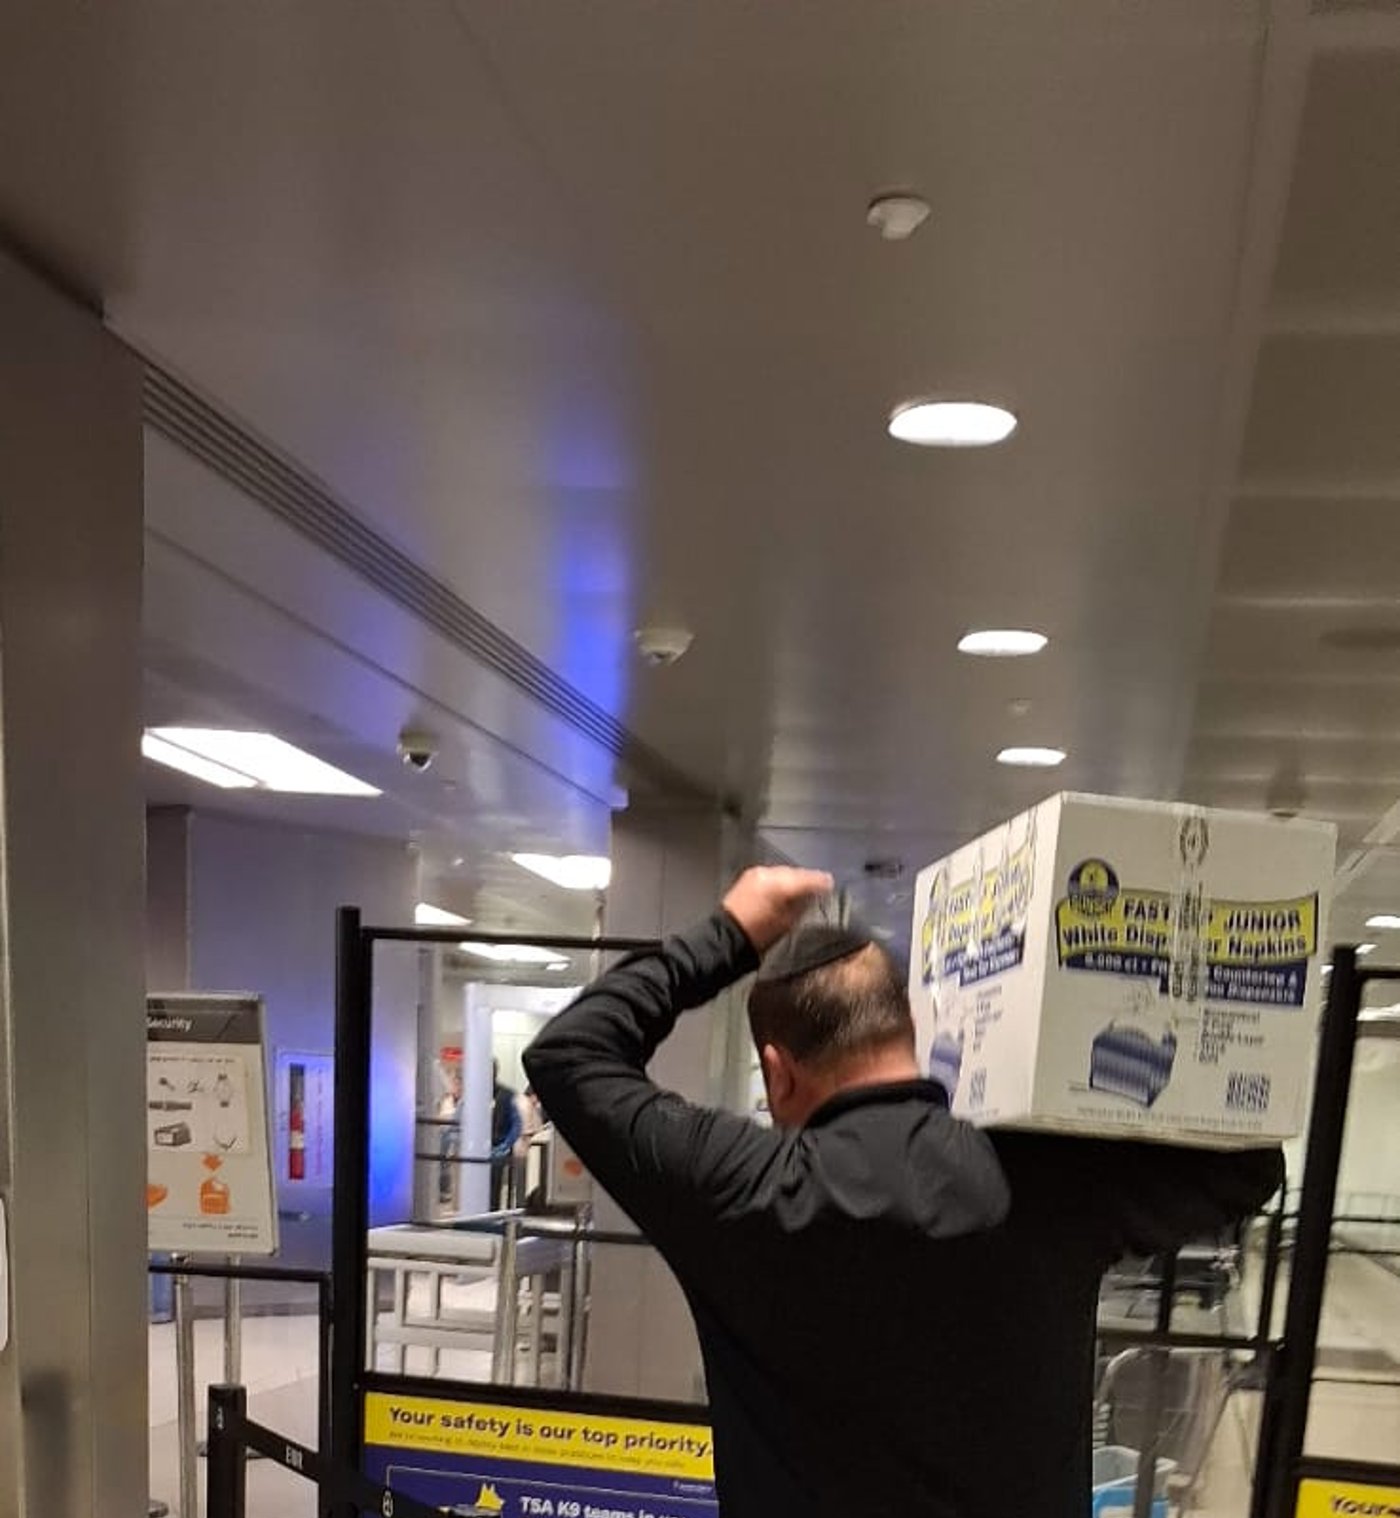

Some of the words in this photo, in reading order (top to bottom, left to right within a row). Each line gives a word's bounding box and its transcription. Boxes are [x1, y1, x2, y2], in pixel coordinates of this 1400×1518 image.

[1123, 898, 1169, 922] FAST
[1223, 909, 1302, 933] JUNIOR
[1062, 923, 1119, 947] White
[1228, 934, 1307, 963] Napkins
[146, 1016, 193, 1032] Security
[389, 1407, 435, 1426] Your
[441, 1412, 510, 1438] safety
[516, 1418, 534, 1437] is
[540, 1425, 576, 1441] our
[582, 1426, 619, 1448] top
[625, 1431, 713, 1458] priority.
[519, 1496, 554, 1515] TSA
[557, 1501, 581, 1518] K9
[1331, 1494, 1387, 1516] Your
